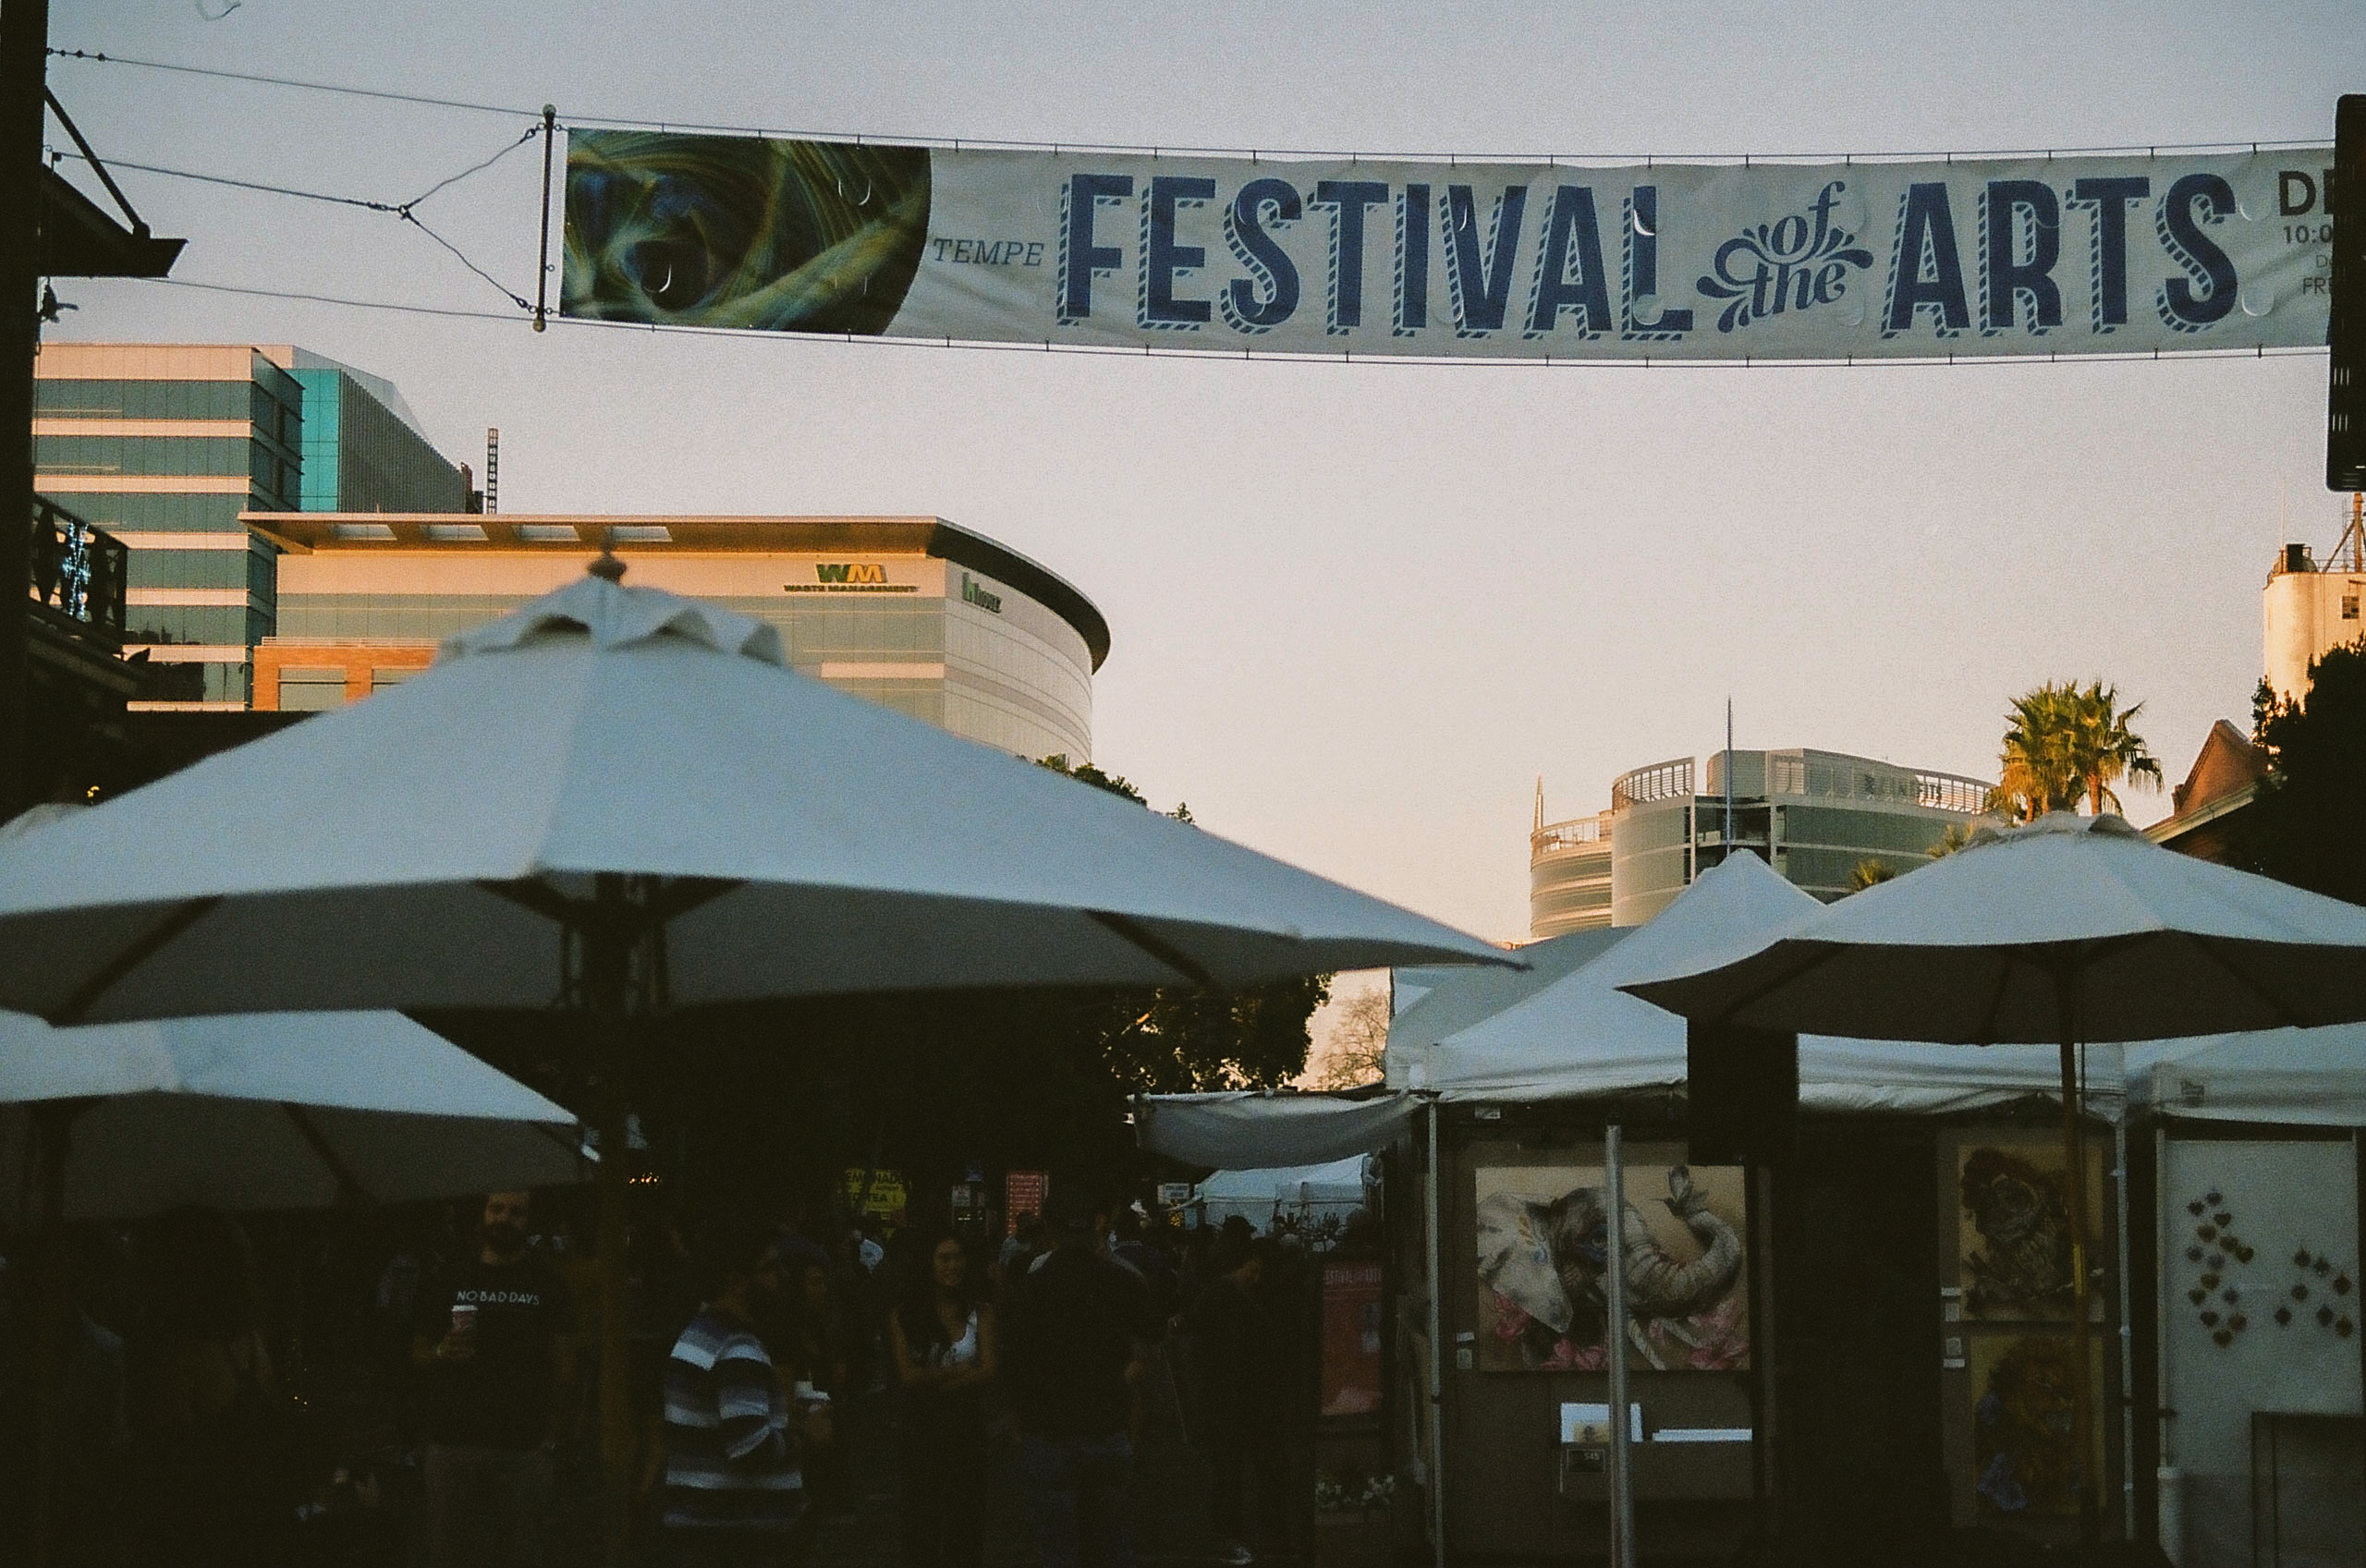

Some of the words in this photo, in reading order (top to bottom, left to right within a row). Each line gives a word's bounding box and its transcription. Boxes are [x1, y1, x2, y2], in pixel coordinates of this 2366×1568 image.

[933, 237, 1044, 267] TEMPE
[1772, 180, 1846, 256] of
[1056, 173, 1693, 340] FESTIVAL
[1738, 251, 1847, 319] the
[1881, 173, 2238, 339] ARTS
[816, 564, 885, 583] WM
[457, 1290, 478, 1302] NO
[480, 1290, 507, 1303] BAD
[509, 1291, 540, 1306] DAYS
